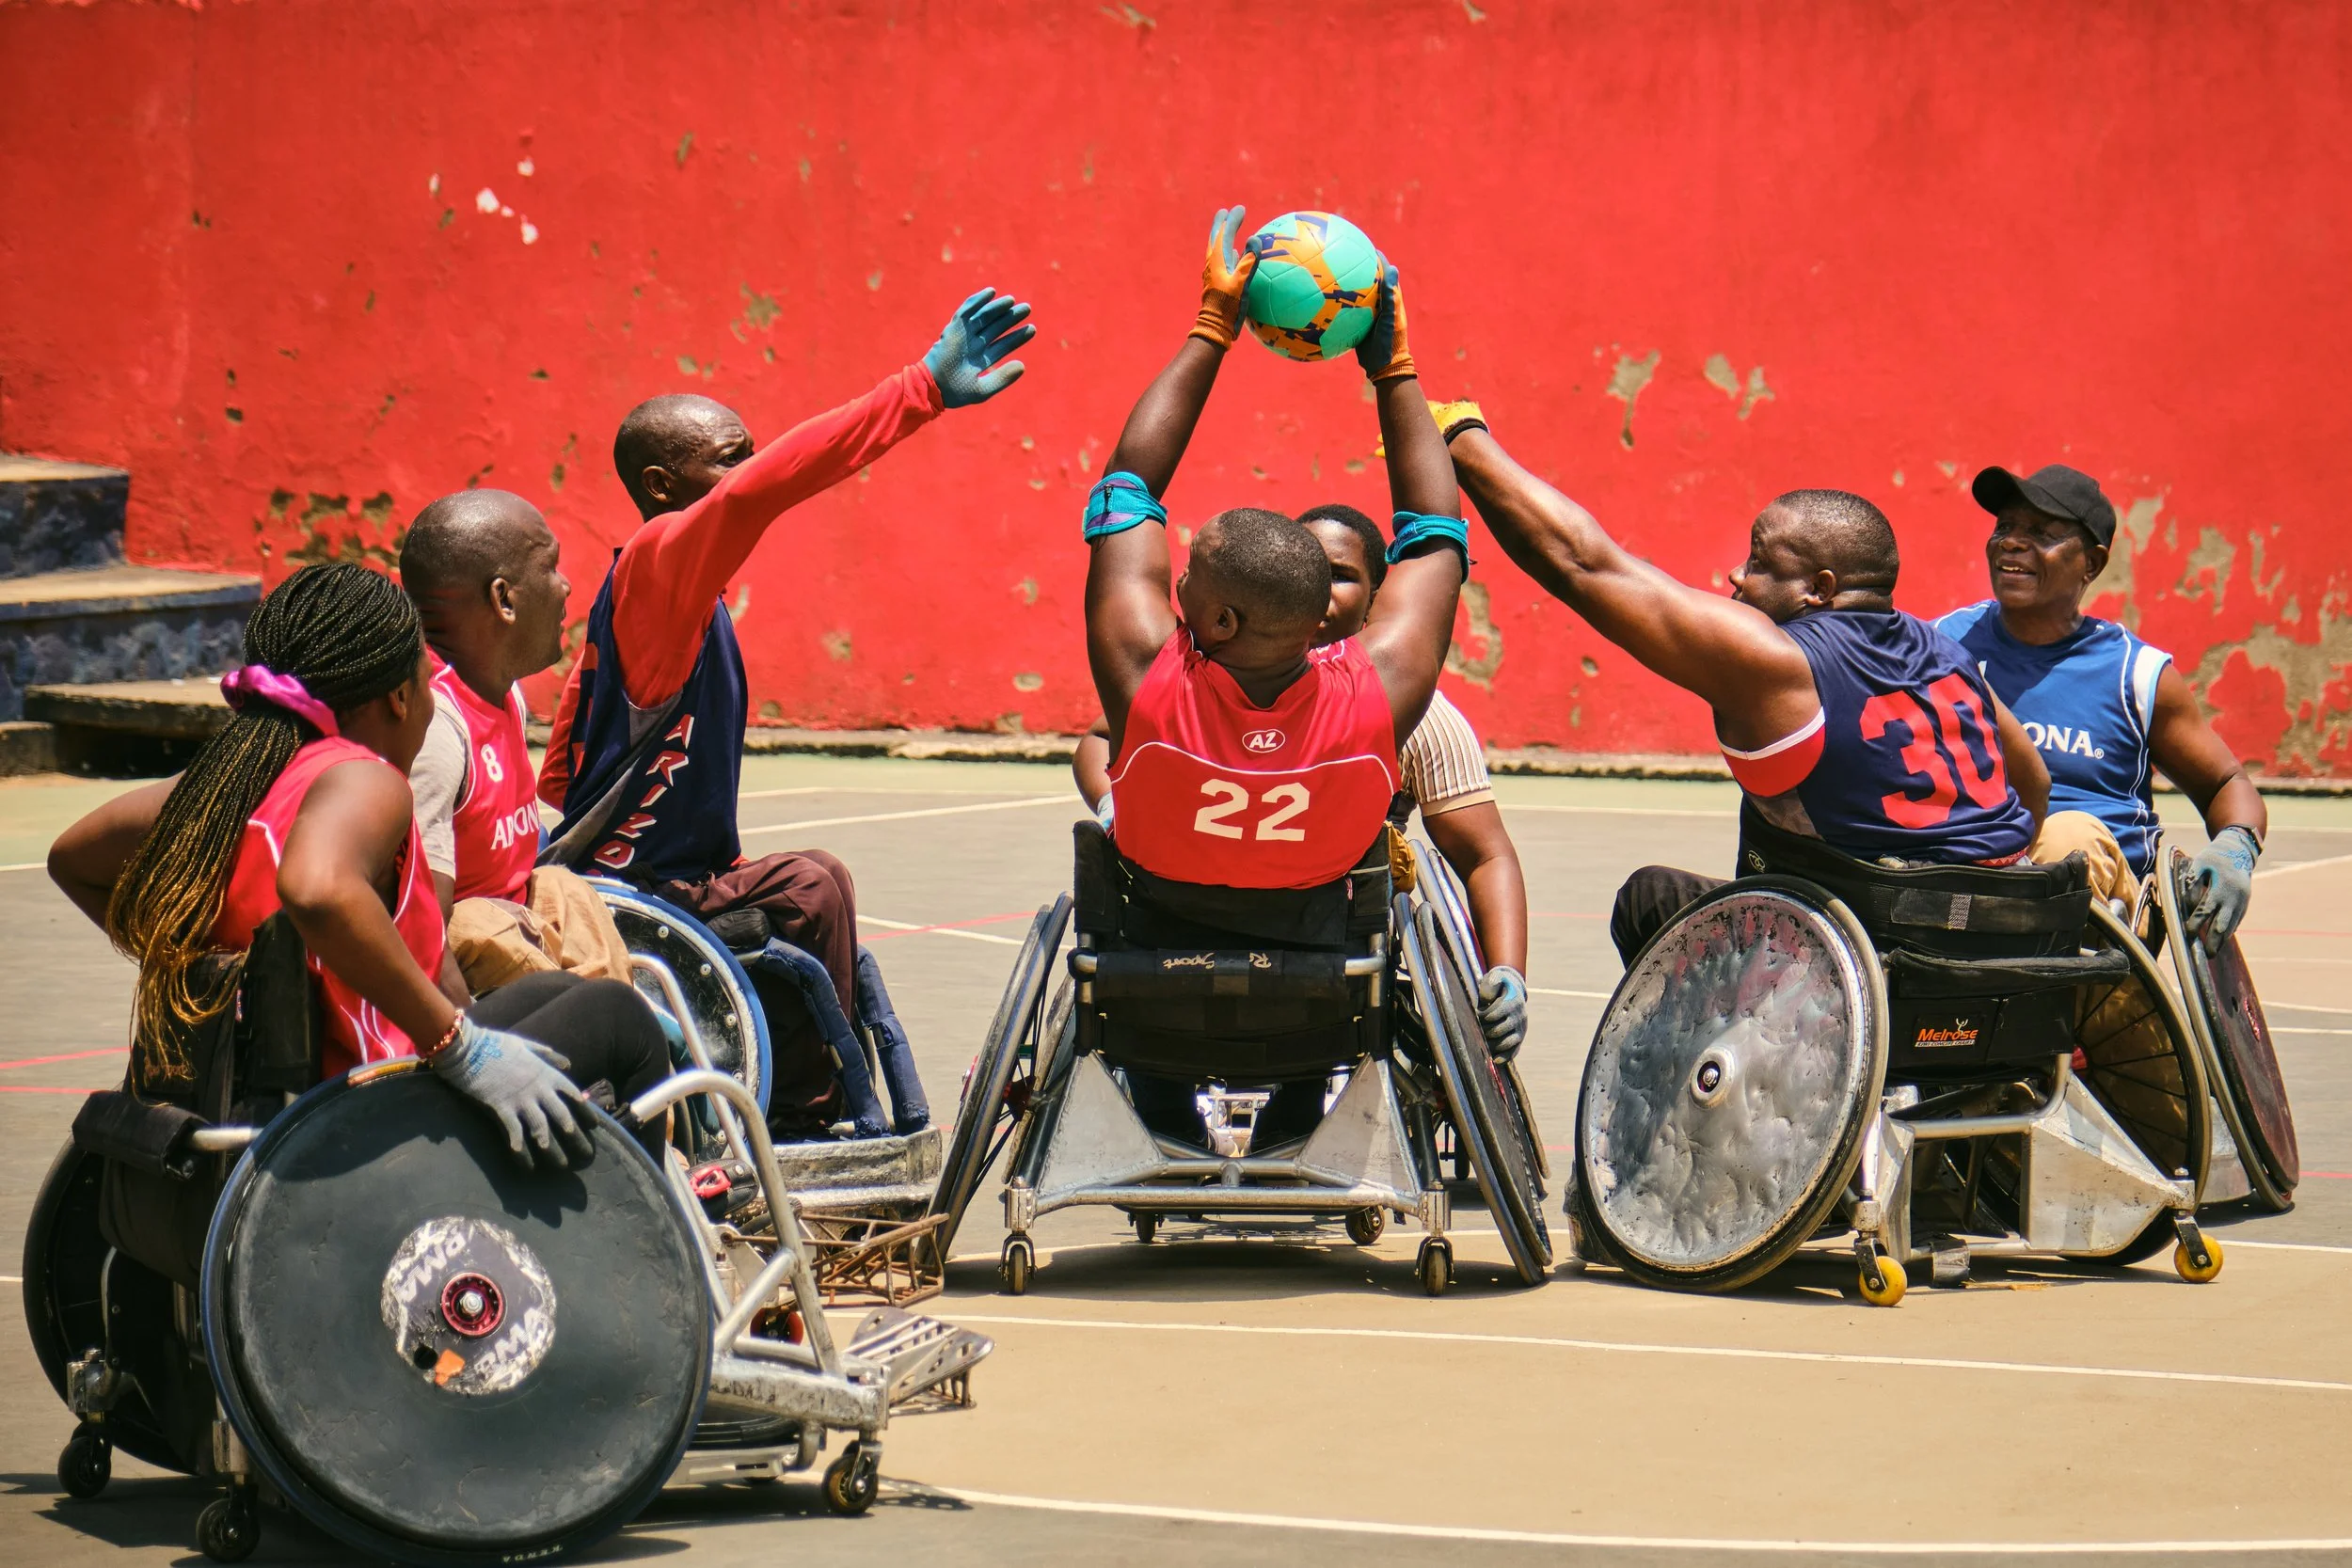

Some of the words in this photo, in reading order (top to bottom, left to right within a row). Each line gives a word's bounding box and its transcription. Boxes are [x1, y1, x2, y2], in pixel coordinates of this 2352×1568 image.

[1248, 731, 1277, 749] AZ
[1859, 673, 2009, 830] 30
[481, 742, 504, 783] 8
[1193, 778, 1311, 842] 22
[1162, 952, 1216, 970] Sport
[1917, 1028, 1979, 1041] Melrose
